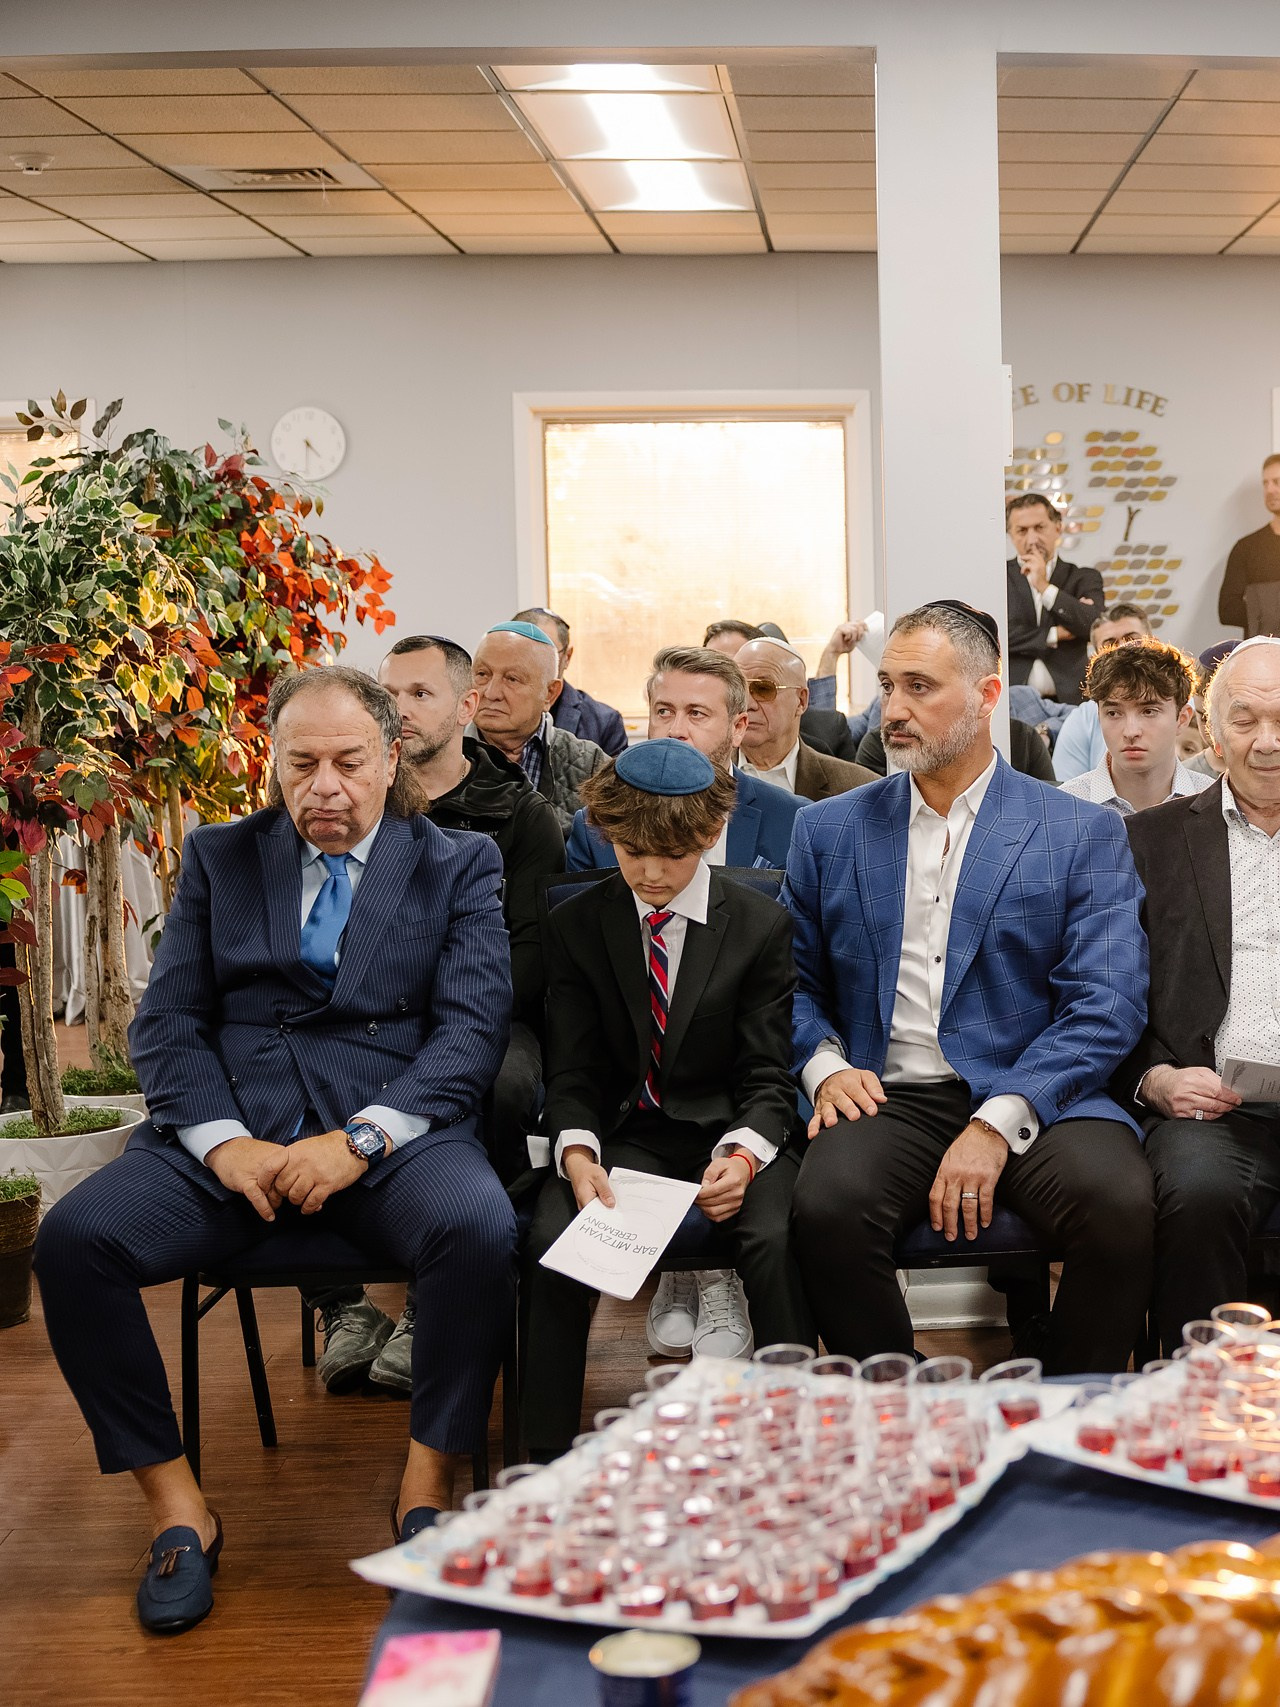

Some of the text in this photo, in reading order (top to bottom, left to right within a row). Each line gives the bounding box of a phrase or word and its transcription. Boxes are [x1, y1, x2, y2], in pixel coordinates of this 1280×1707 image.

[1052, 382, 1092, 403] OF
[1103, 383, 1169, 417] LIFE
[579, 1224, 658, 1255] BAR MITZVAH
[584, 1216, 637, 1241] CEREMONY
